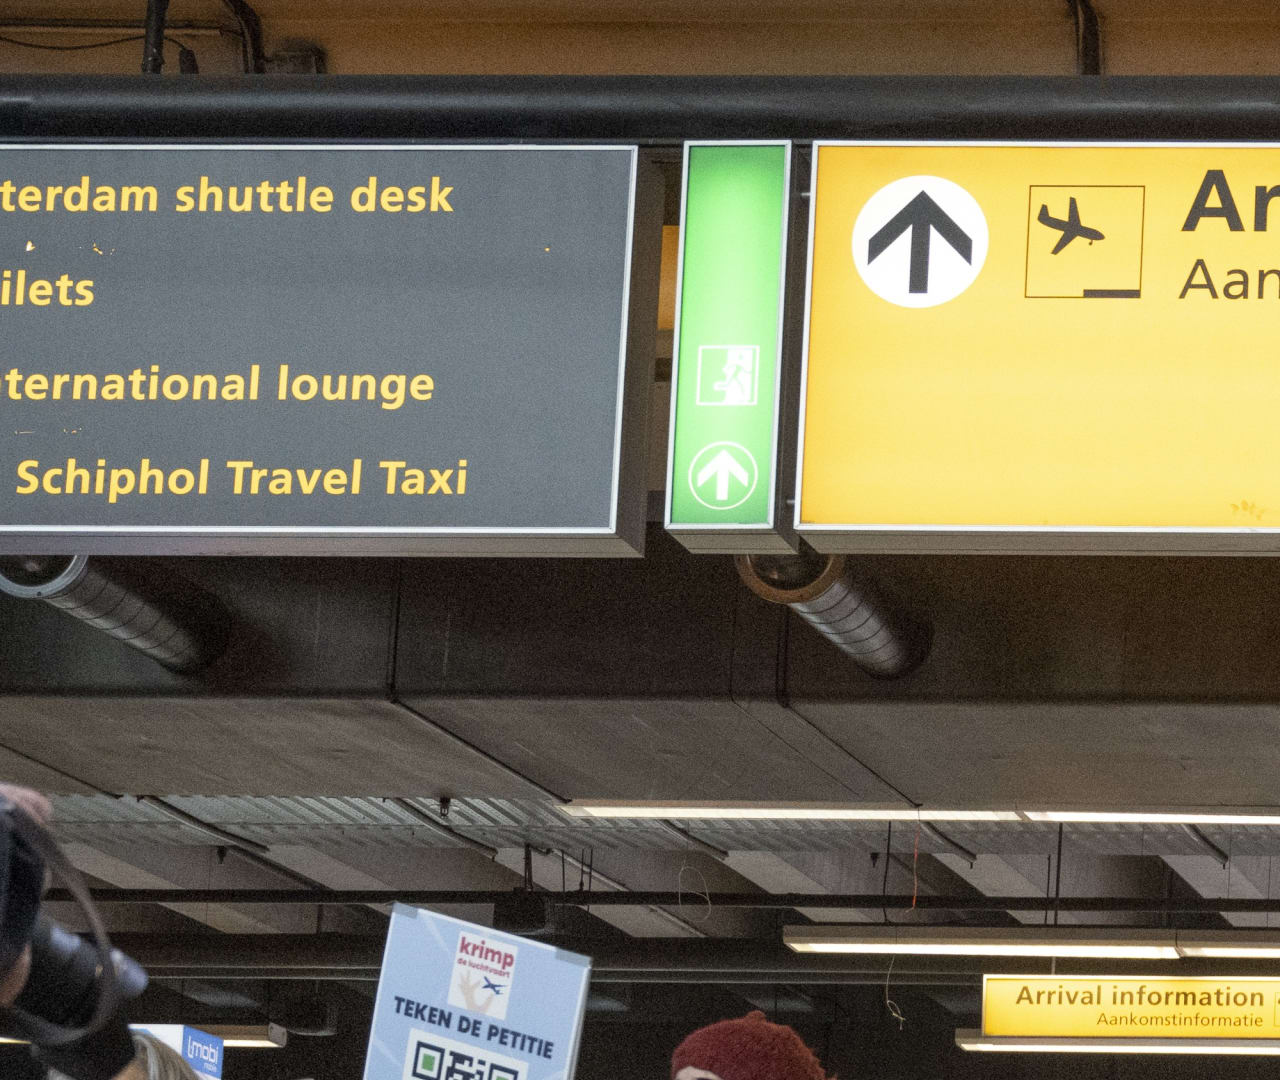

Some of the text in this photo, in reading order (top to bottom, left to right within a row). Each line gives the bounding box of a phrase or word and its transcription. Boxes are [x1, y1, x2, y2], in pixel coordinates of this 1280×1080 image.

[176, 177, 335, 213] shuttle
[351, 177, 454, 213] desk
[1, 270, 96, 308] ilets
[278, 365, 436, 411] lounge
[16, 459, 469, 505] Schiphol Travel Taxi
[457, 957, 511, 979] de luchtvaart
[459, 936, 515, 969] krimp
[1015, 985, 1265, 1006] Arrival information
[394, 996, 555, 1059] TEKEN DE PETITIE
[1096, 1012, 1264, 1027] Aankomstinformatie
